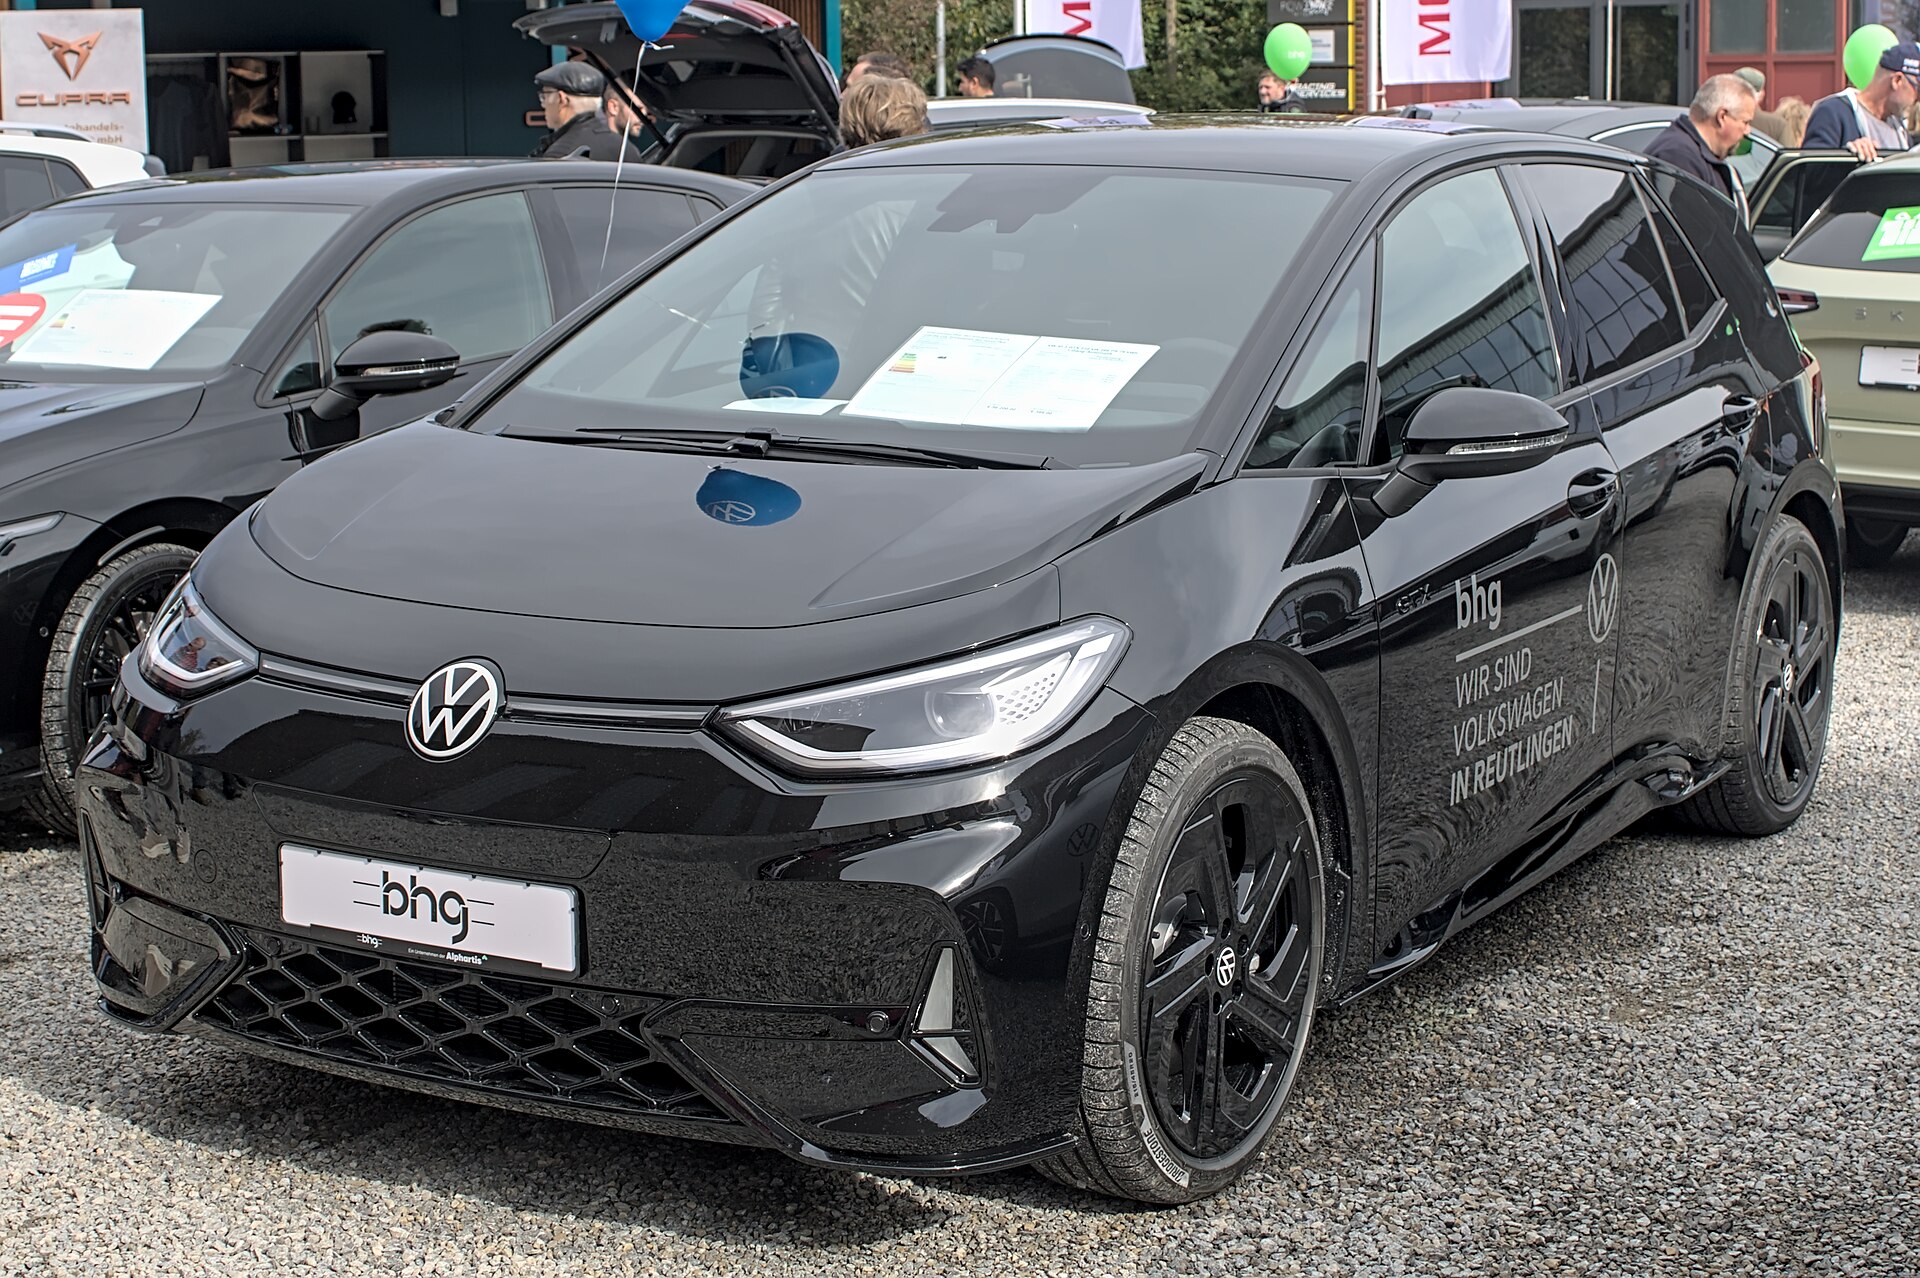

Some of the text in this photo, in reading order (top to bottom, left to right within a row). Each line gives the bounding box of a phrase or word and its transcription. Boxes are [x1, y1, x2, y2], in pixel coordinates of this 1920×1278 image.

[16, 92, 130, 107] CUPRA
[1455, 574, 1501, 630] bhg
[1456, 647, 1532, 708] WIR SIND
[1453, 676, 1564, 756] VOLKSWAGEN
[1450, 715, 1573, 806] IN REUTLINGEN
[382, 870, 469, 945] bhg
[361, 934, 379, 948] bhg
[445, 952, 483, 965] Alphartis
[1143, 1128, 1185, 1183] BRIDGESTONE
